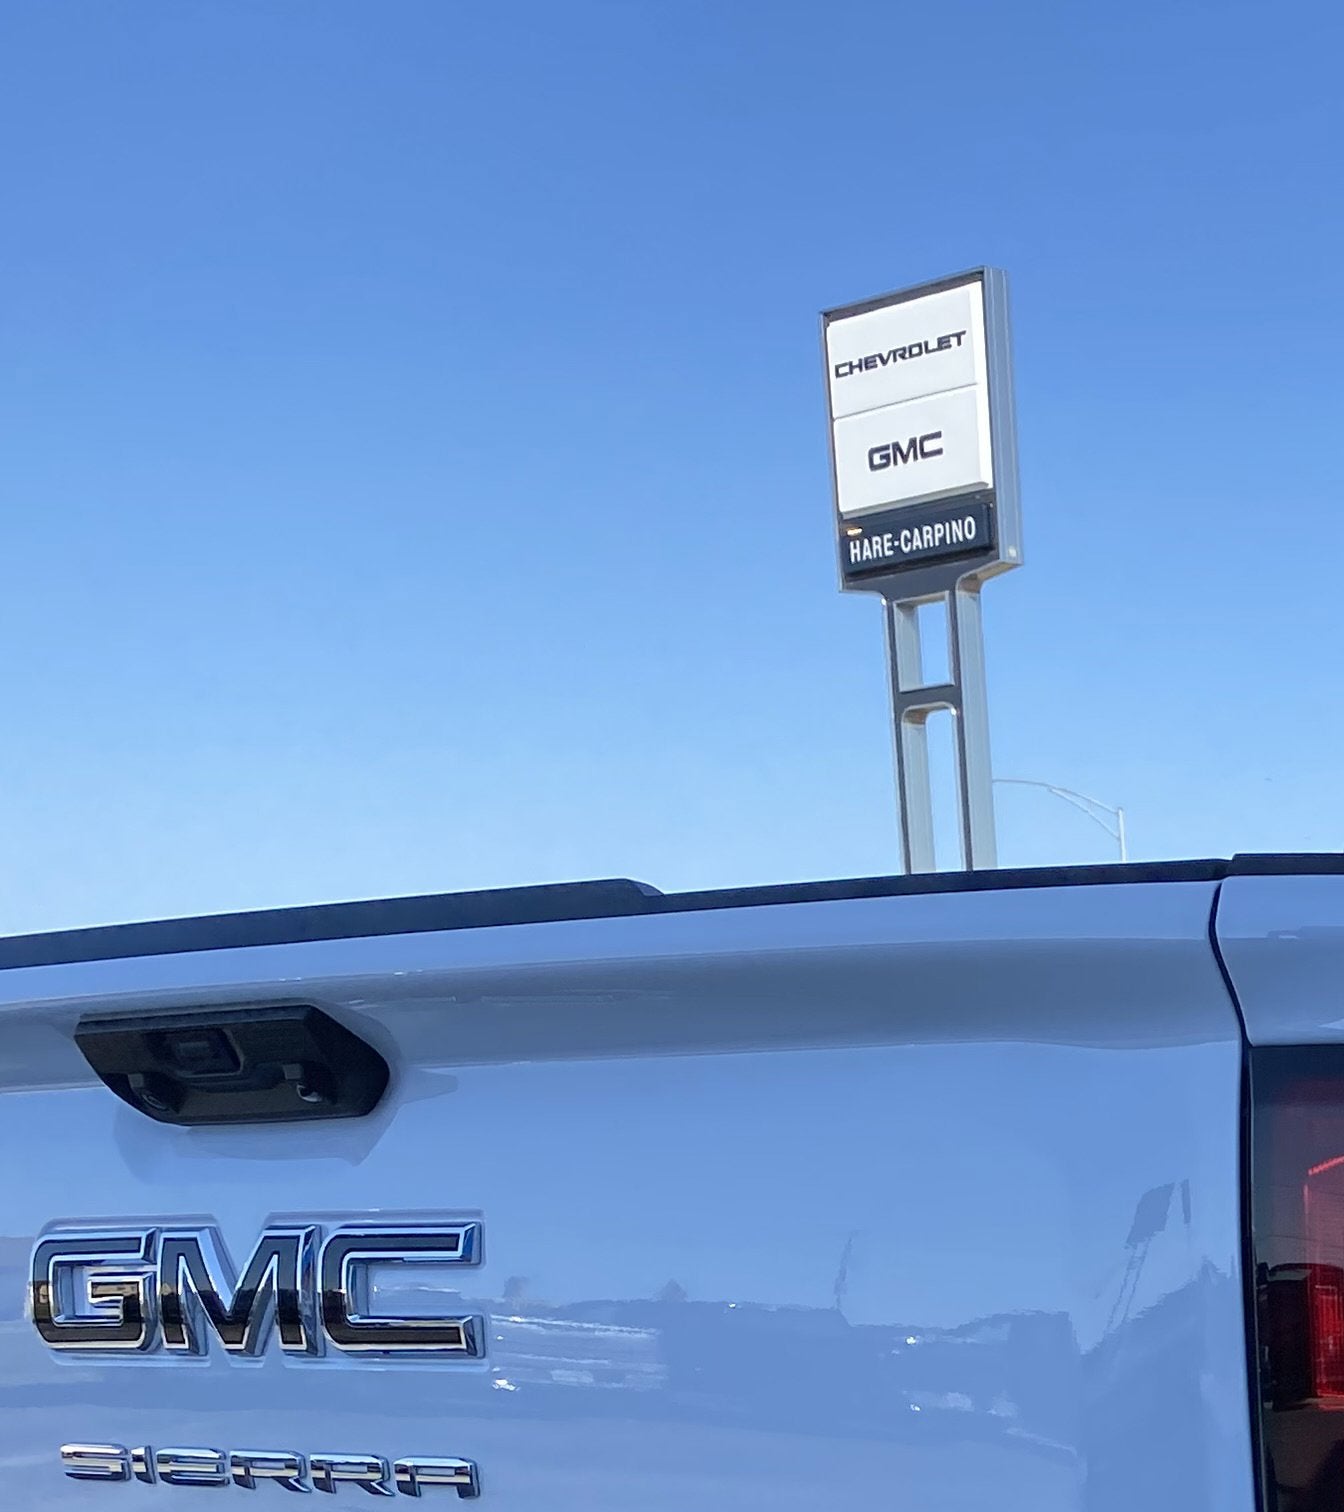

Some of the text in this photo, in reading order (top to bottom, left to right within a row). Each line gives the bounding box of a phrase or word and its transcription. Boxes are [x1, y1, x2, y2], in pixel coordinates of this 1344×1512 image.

[834, 330, 967, 379] CHEVROLET
[867, 430, 944, 472] GMC
[849, 515, 977, 564] HARE-CARPINO
[30, 1222, 487, 1359] GMC
[59, 1442, 483, 1500] SIERRA
